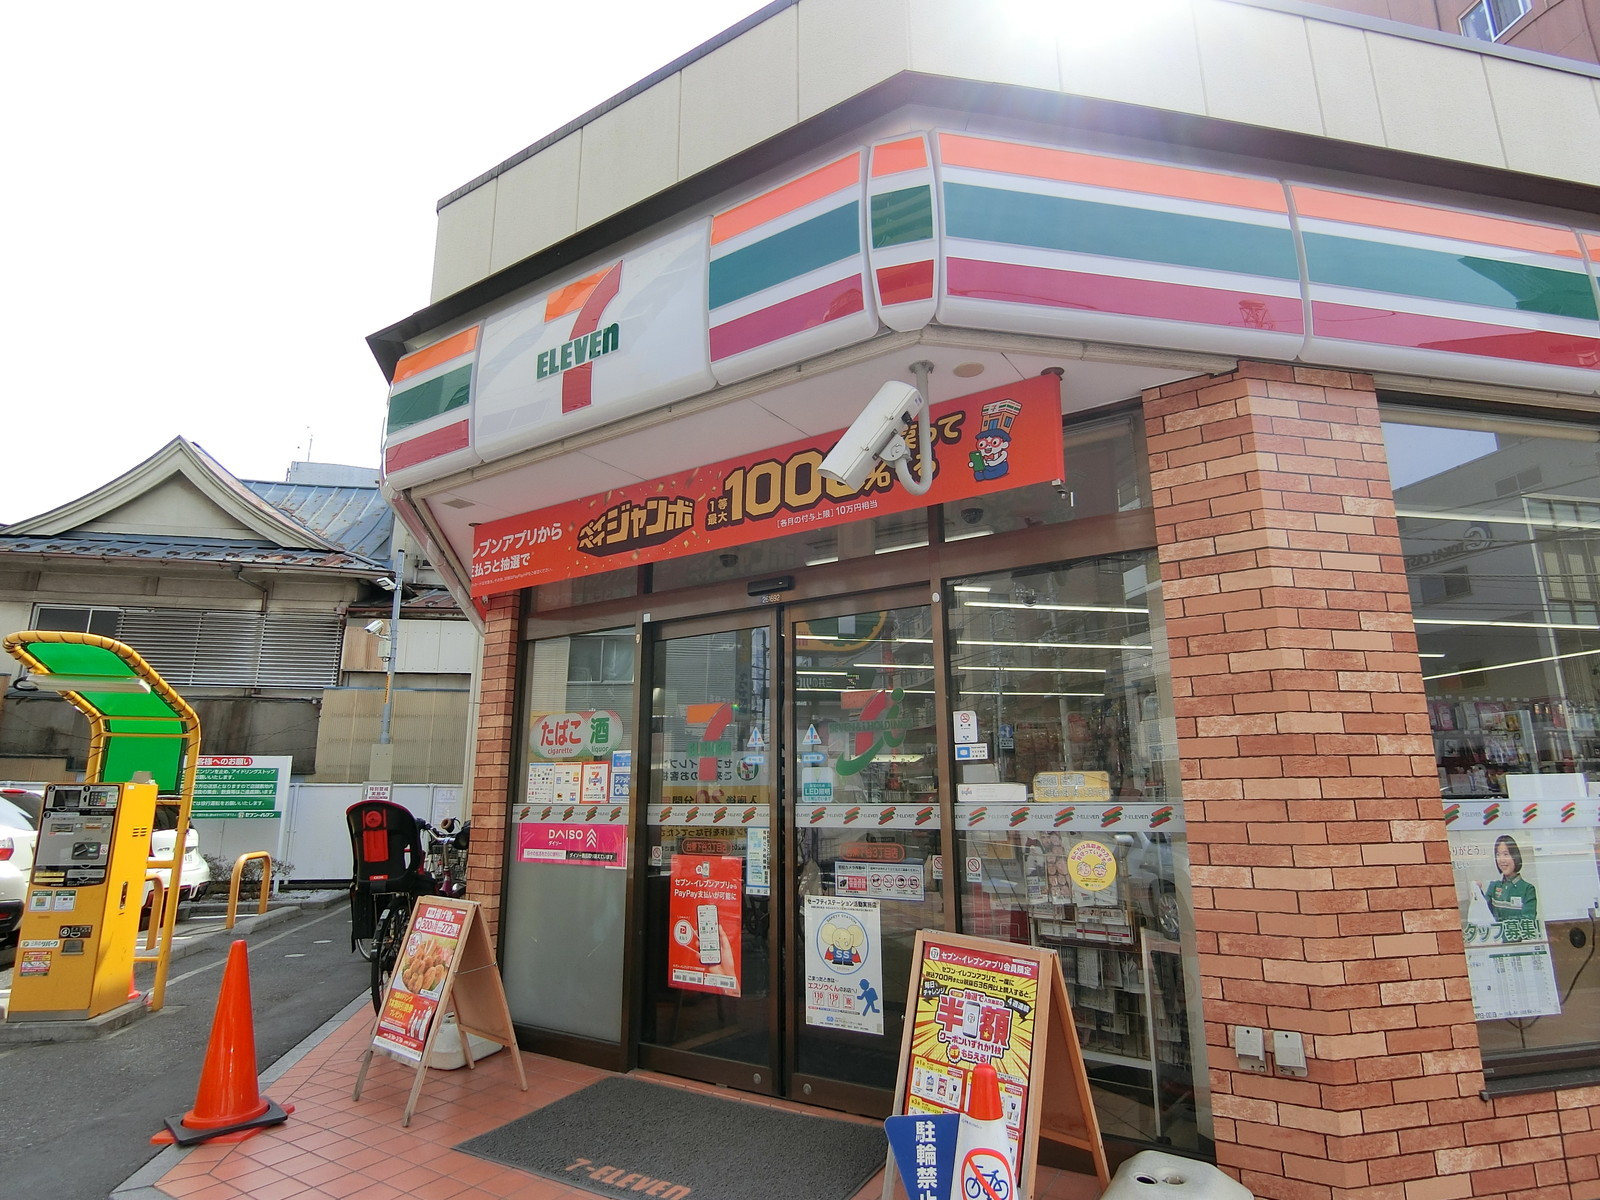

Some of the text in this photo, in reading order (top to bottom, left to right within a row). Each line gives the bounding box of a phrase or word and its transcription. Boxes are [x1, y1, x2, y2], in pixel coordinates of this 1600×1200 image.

[536, 258, 623, 414] 7 ELEVEn
[707, 497, 729, 513] 1等
[835, 499, 879, 517] 10万円相当
[605, 499, 694, 545] ジャンボ
[706, 511, 729, 527] 最大
[540, 719, 582, 747] たばこ
[590, 717, 610, 744] 酒
[547, 747, 573, 755] cigarette
[548, 829, 584, 840] DAISO
[1450, 845, 1487, 857] りがとう」
[836, 950, 850, 959] SS
[923, 986, 946, 996] チャレンジ
[964, 991, 984, 1003] 抽選で
[937, 996, 1012, 1046] 半額
[960, 1049, 990, 1063] もらえる!
